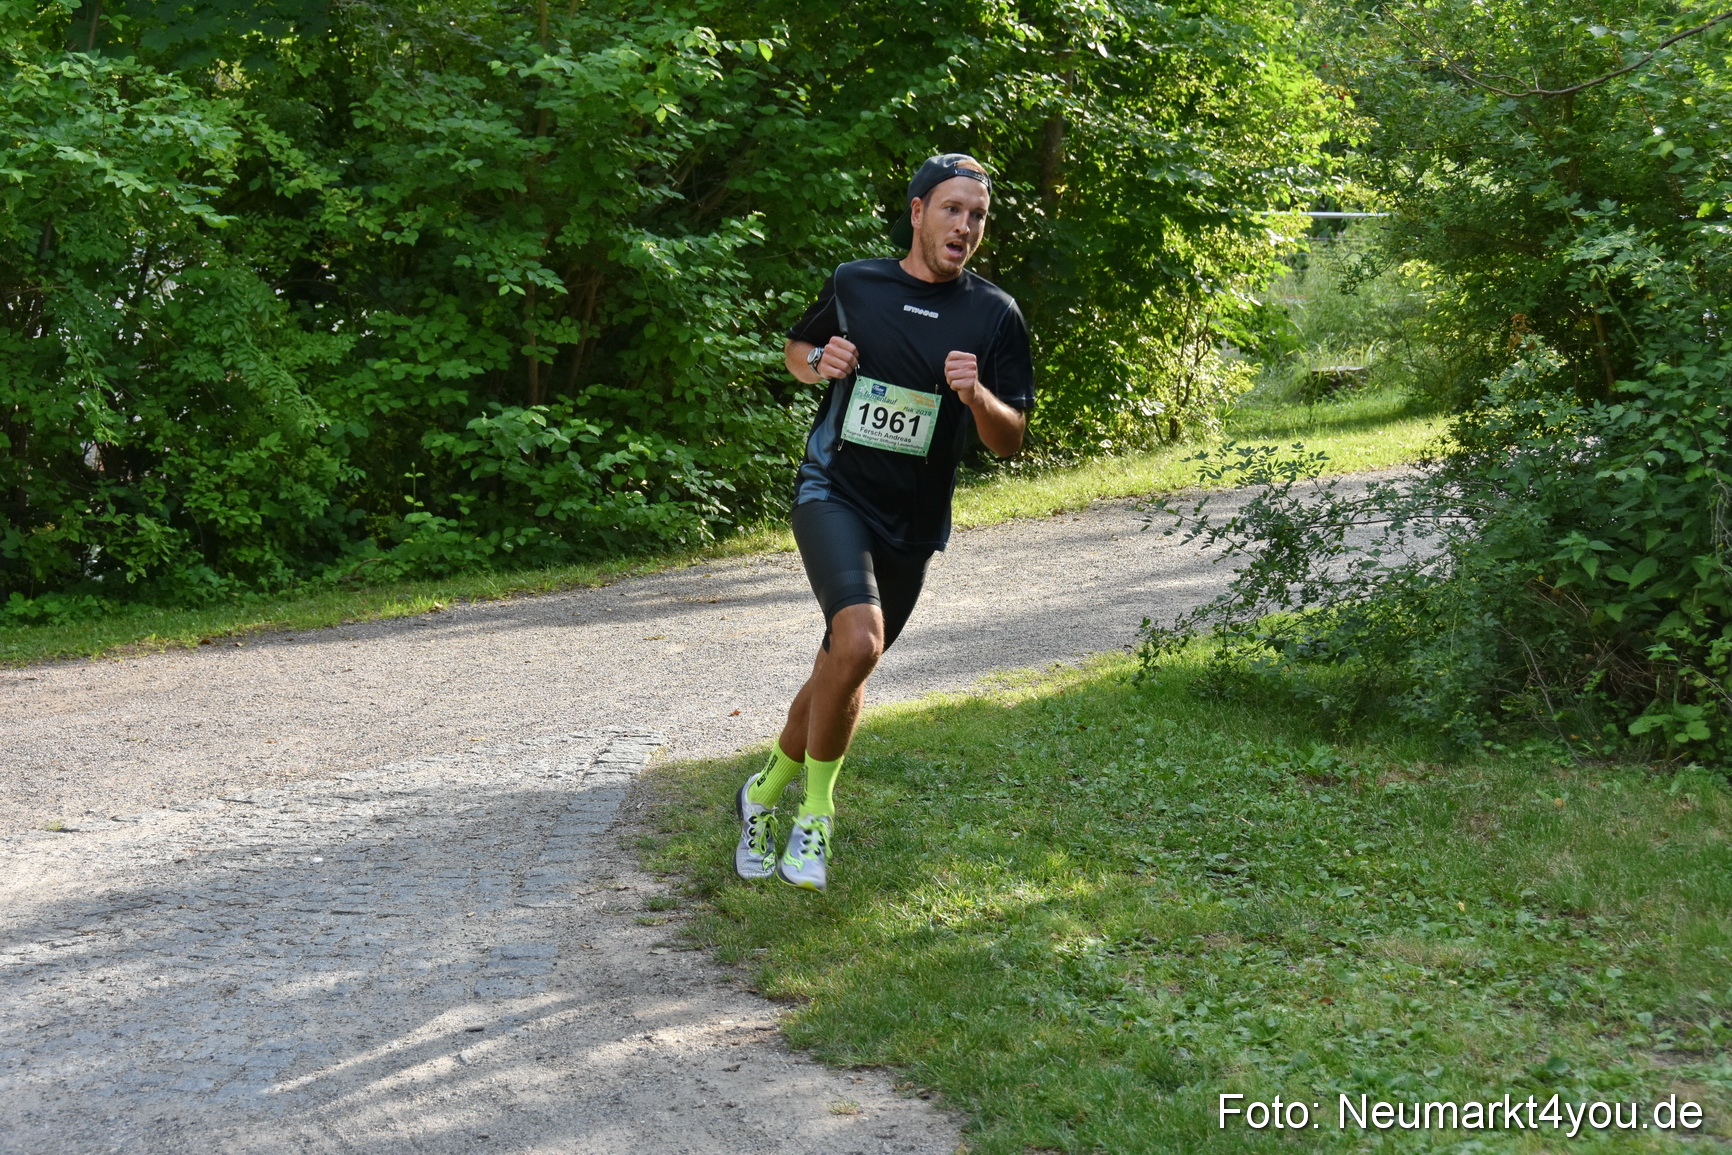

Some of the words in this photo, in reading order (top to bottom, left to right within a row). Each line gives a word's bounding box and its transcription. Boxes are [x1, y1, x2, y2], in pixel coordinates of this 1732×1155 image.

[858, 402, 921, 437] 1961
[860, 426, 882, 438] Fersch
[884, 432, 912, 443] Andreas
